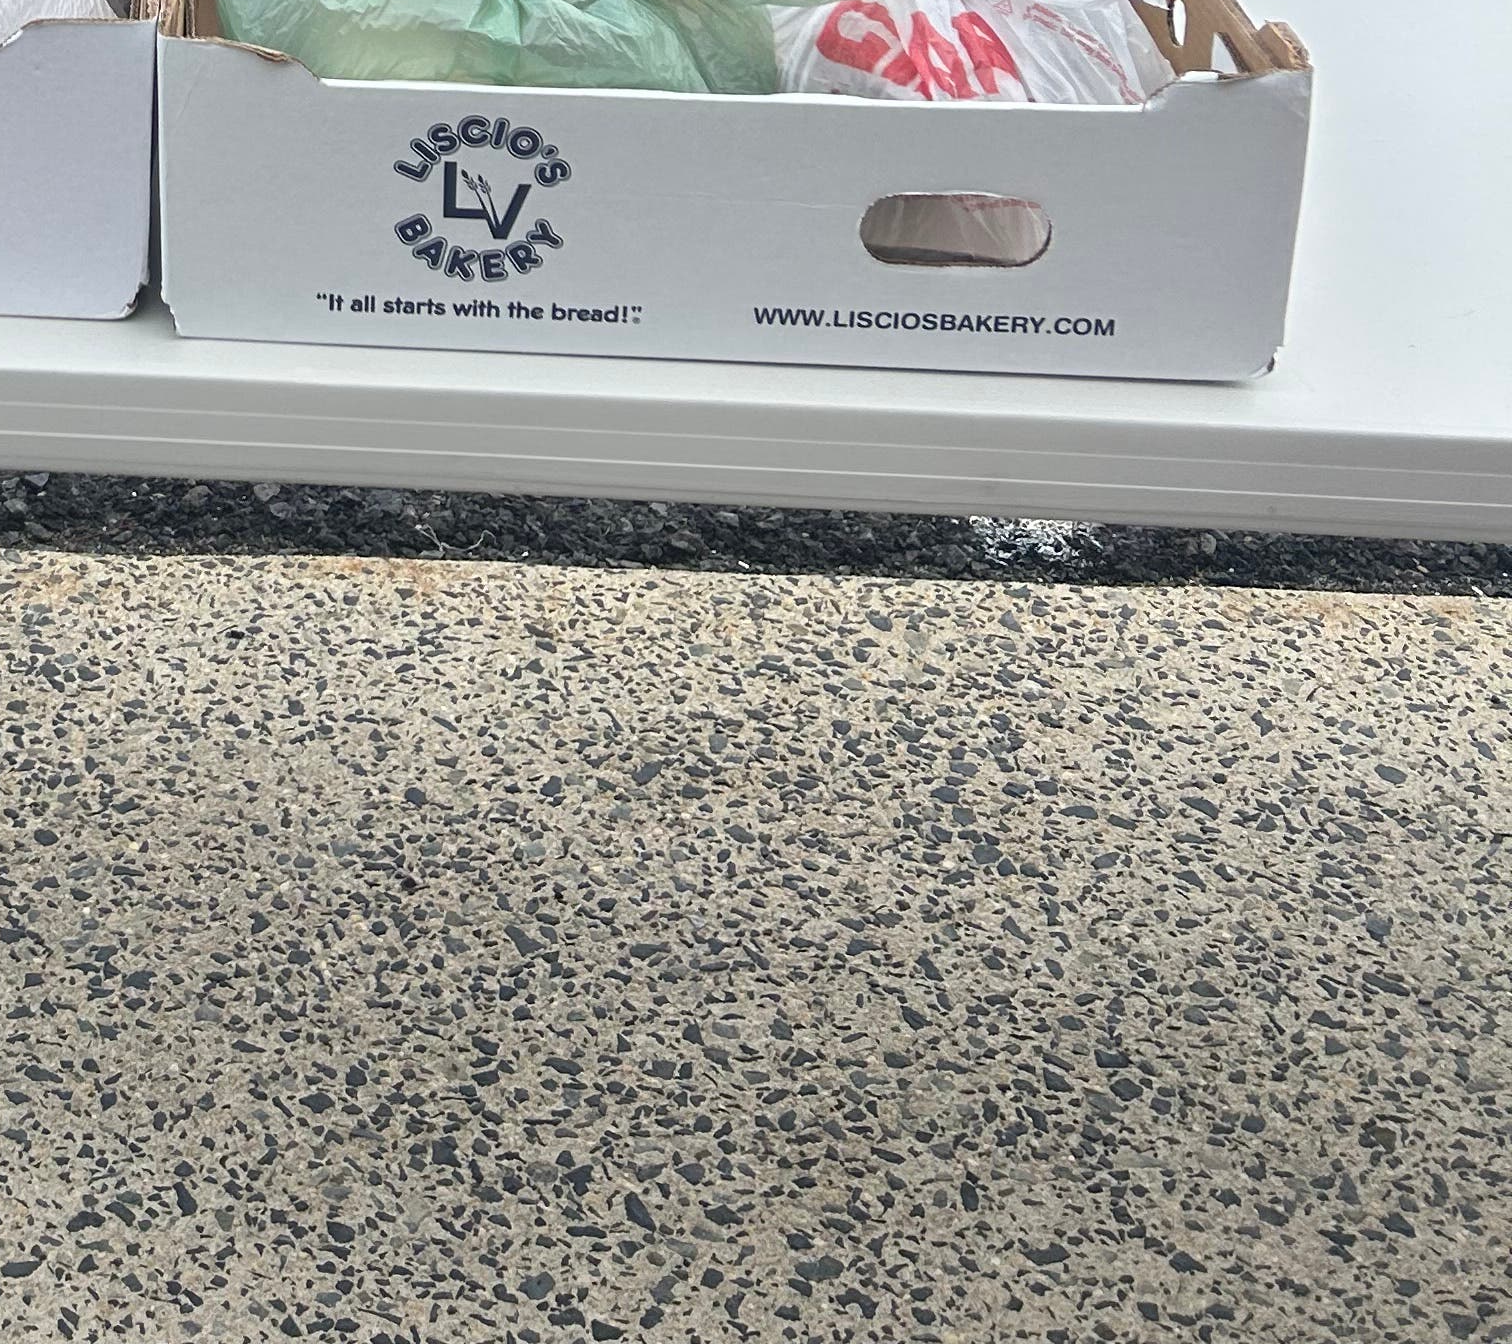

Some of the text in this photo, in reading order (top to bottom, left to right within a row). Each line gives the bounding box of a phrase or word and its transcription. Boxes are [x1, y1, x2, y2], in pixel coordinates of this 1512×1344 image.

[393, 115, 572, 187] LISCIO'S
[394, 213, 564, 282] BAKERY
[350, 295, 376, 313] all
[383, 296, 446, 316] starts
[452, 299, 501, 318] with
[507, 301, 544, 320] the
[753, 307, 1116, 336] WWW.LISCIOSBAKERY.COM
